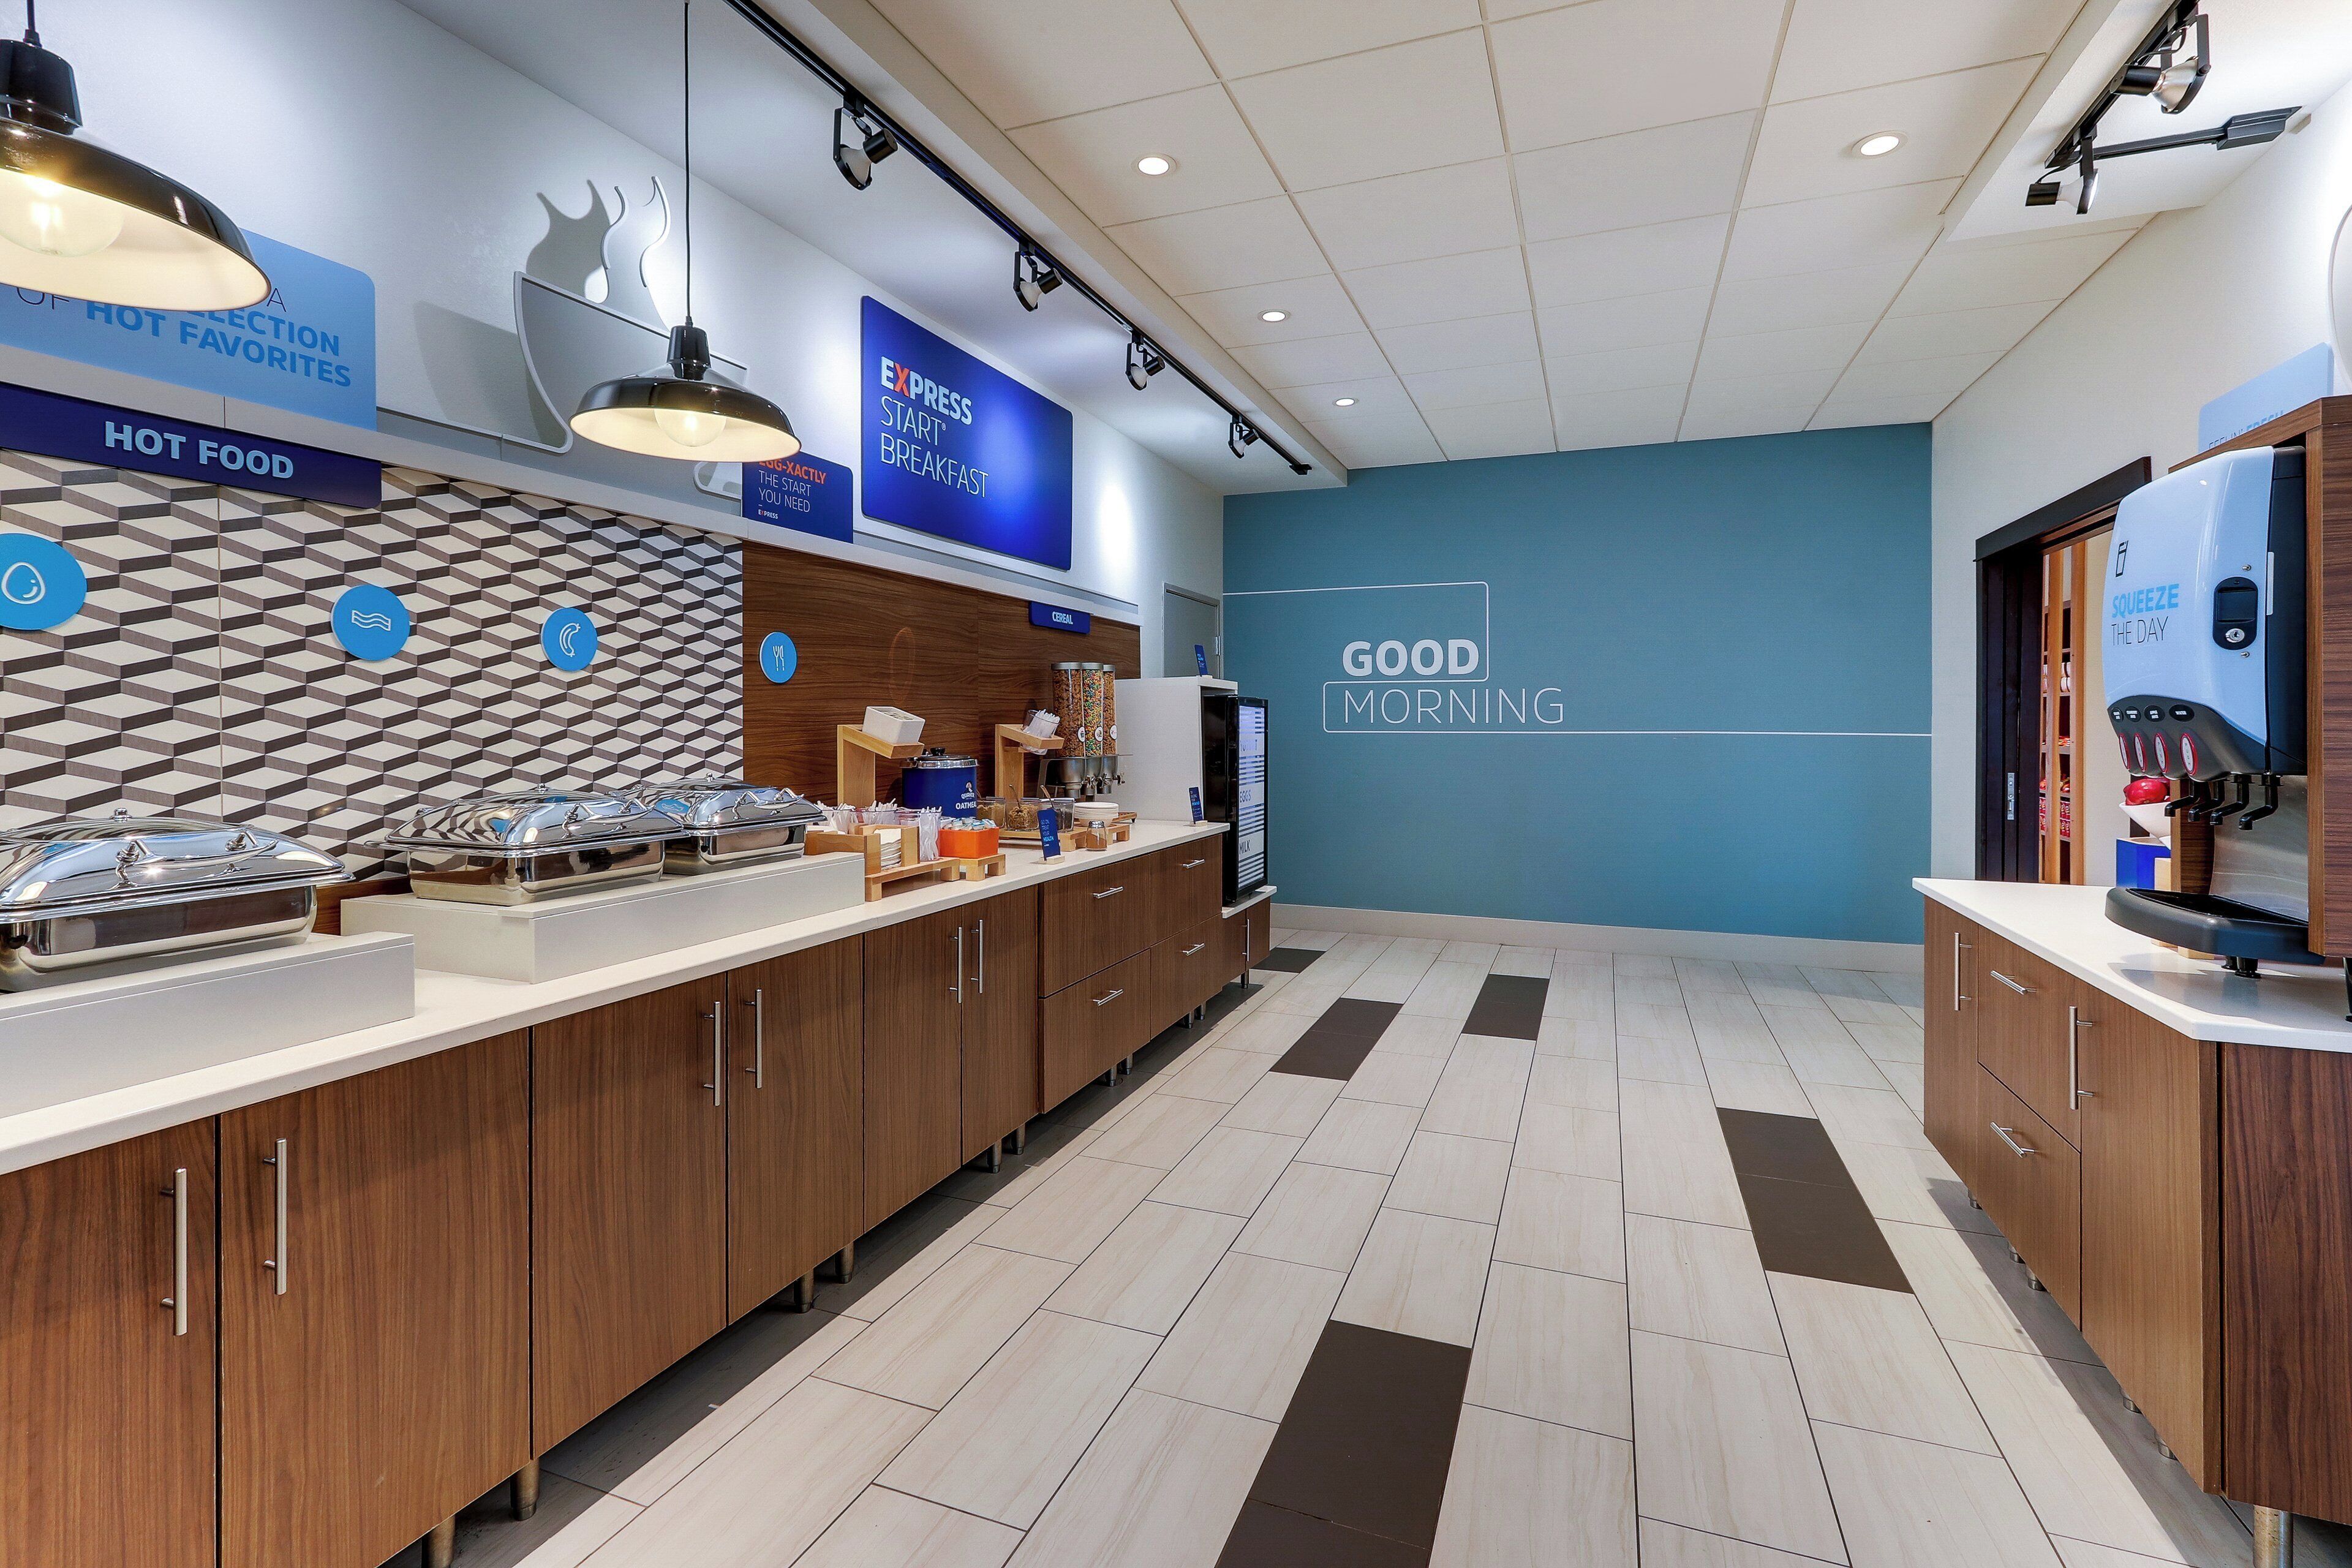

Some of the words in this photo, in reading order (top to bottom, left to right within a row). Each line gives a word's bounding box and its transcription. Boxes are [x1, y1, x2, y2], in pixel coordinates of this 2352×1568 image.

[266, 288, 287, 312] A
[86, 301, 166, 337] HOT
[179, 320, 351, 387] FAVORITES
[186, 308, 339, 356] LECTION
[881, 356, 973, 425] EXPRESS
[105, 421, 186, 459] HOT
[198, 439, 293, 478] FOOD
[881, 432, 989, 498] BREAKFAST
[758, 470, 778, 488] THE
[782, 477, 812, 497] START
[758, 487, 781, 505] YOU
[785, 494, 810, 513] NEED
[758, 509, 778, 519] EXPRESS
[2112, 583, 2179, 619] SQUEEZE
[1052, 611, 1073, 625] CEREAL
[2111, 620, 2132, 646] THE
[2137, 616, 2169, 643] DAY
[1342, 639, 1480, 677] GOOD
[1344, 687, 1564, 725] MORNING
[956, 801, 977, 810] OATMEA
[1240, 789, 1251, 803] EGGS
[1239, 839, 1251, 854] MILK
